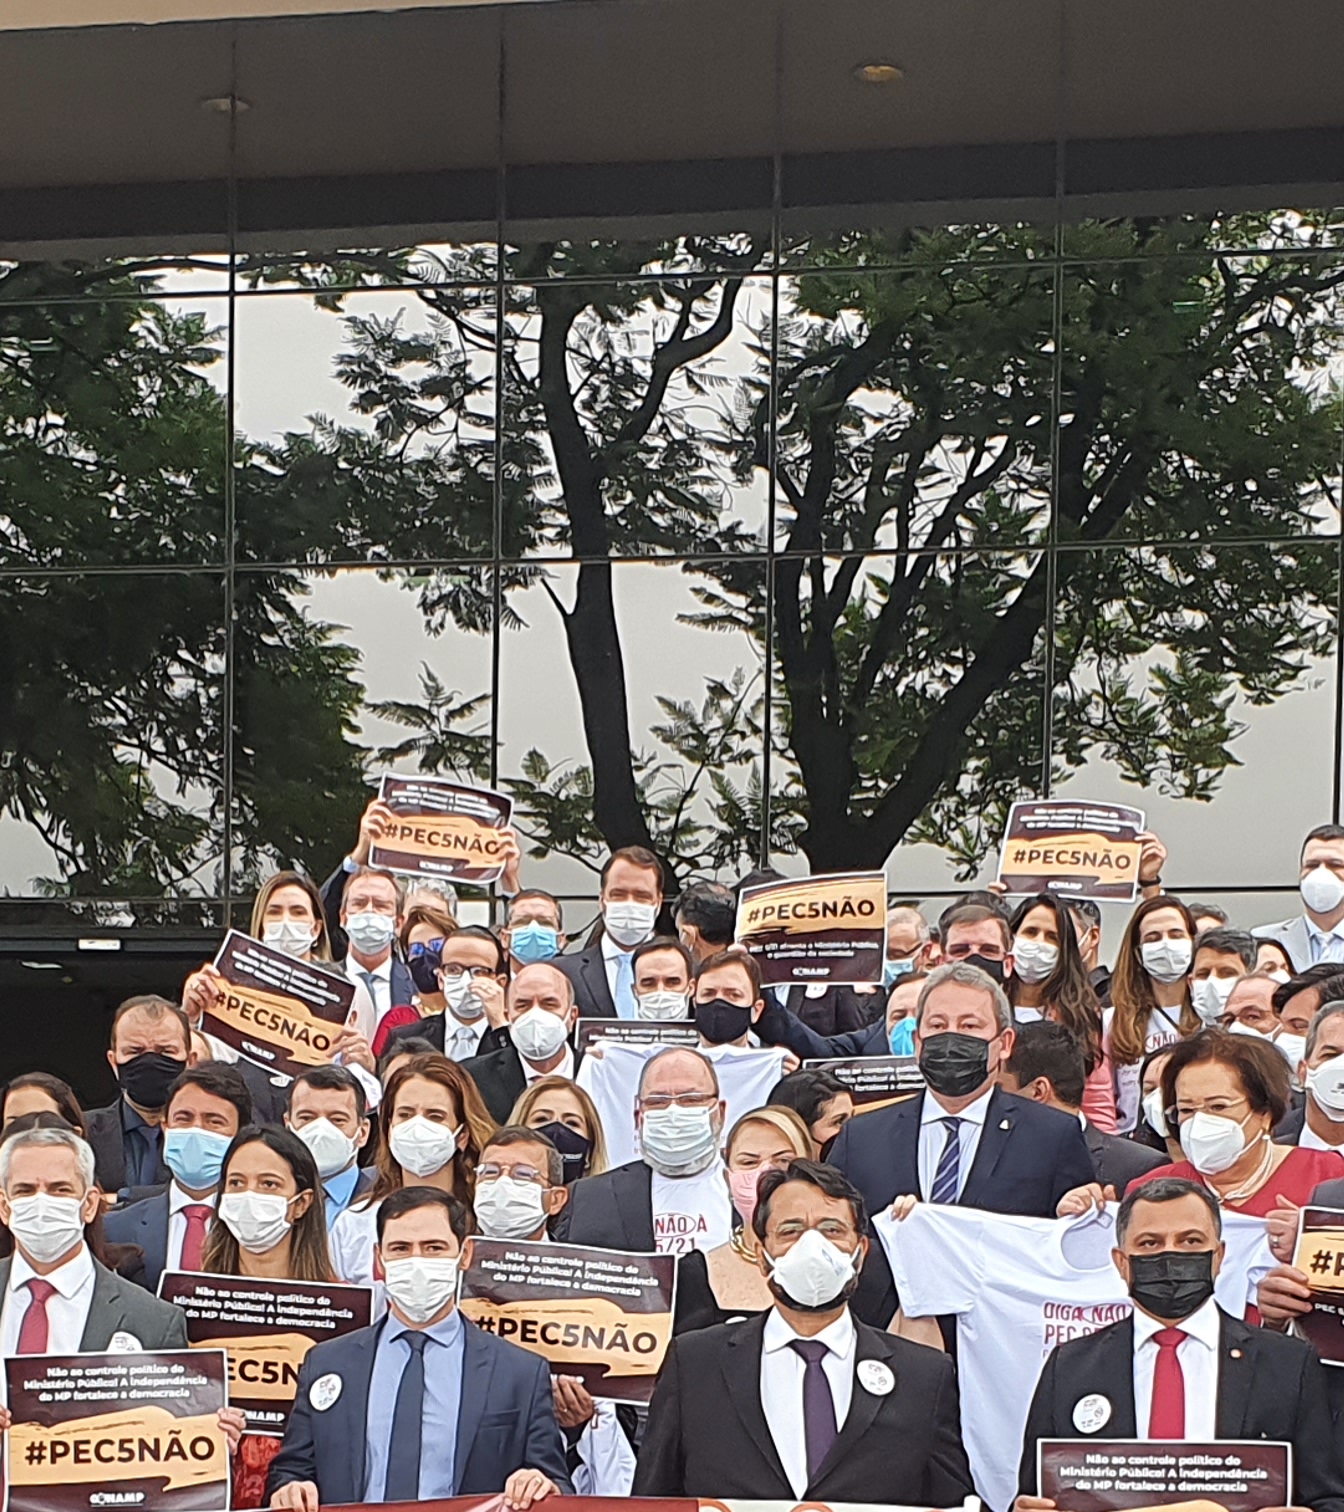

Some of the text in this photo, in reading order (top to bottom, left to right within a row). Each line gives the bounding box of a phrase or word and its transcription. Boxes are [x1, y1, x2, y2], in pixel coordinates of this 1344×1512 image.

[383, 823, 500, 855] #PEC5NÃO
[1013, 848, 1130, 870] #PEC5NÃO
[747, 895, 874, 923] #PEC5NÃO
[216, 992, 330, 1050] #PEC5NÃO
[1044, 1302, 1082, 1321] DIGA
[475, 1316, 656, 1354] #PEC5NÃO
[48, 1368, 68, 1377] Não
[171, 1364, 184, 1373] do
[25, 1430, 215, 1465] #PEC5NÃO
[1086, 1454, 1108, 1465] Não
[1111, 1456, 1126, 1465] ao
[1128, 1455, 1176, 1465] controle
[1225, 1456, 1240, 1465] do
[1094, 1481, 1111, 1490] MP
[1178, 1482, 1247, 1492] democracia
